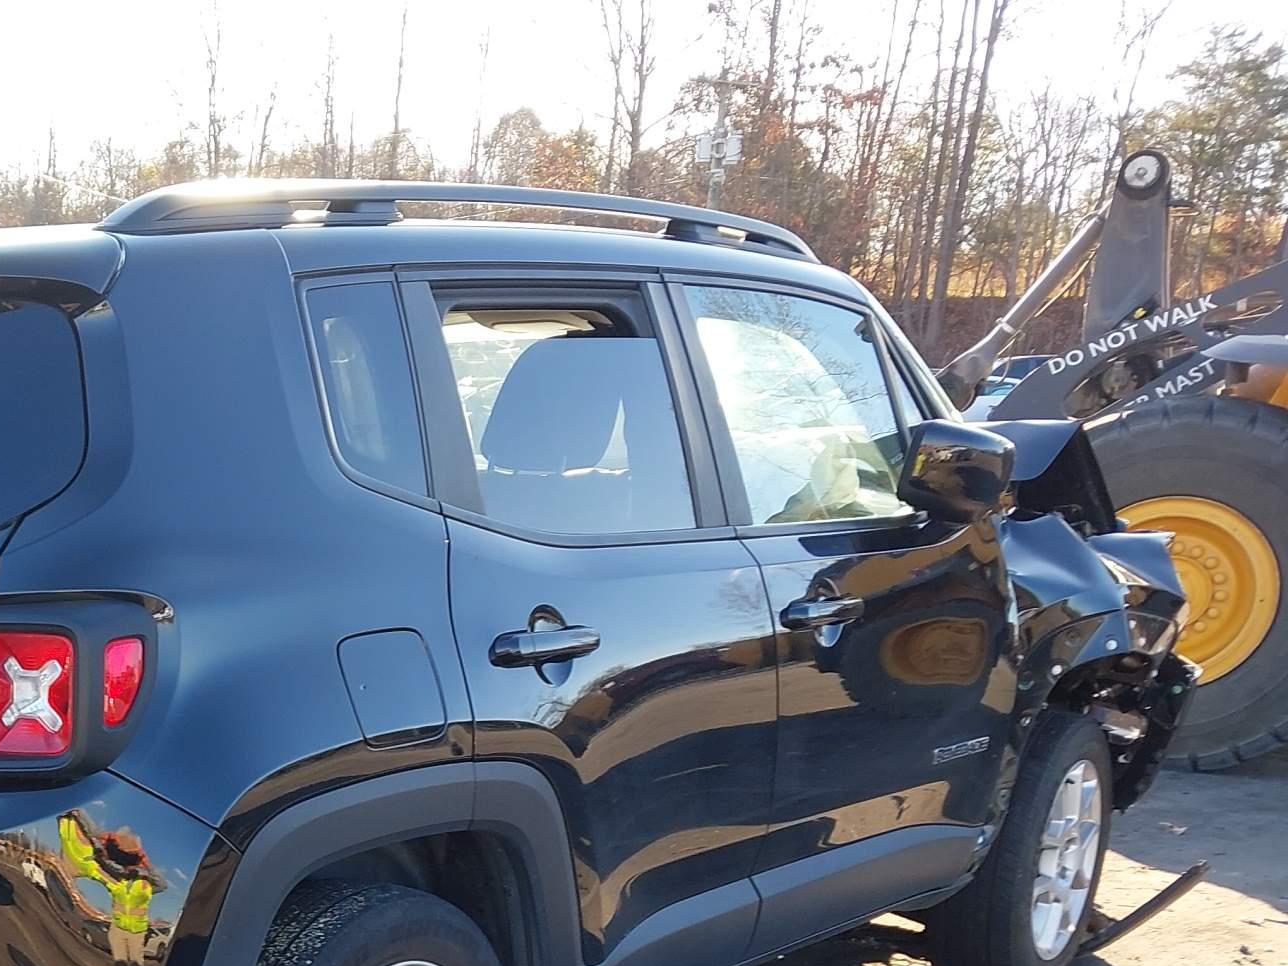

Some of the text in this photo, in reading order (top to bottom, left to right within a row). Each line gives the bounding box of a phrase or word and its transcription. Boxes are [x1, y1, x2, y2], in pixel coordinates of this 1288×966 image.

[1047, 294, 1219, 375] DO NOT WALK
[1155, 358, 1216, 399] MAST
